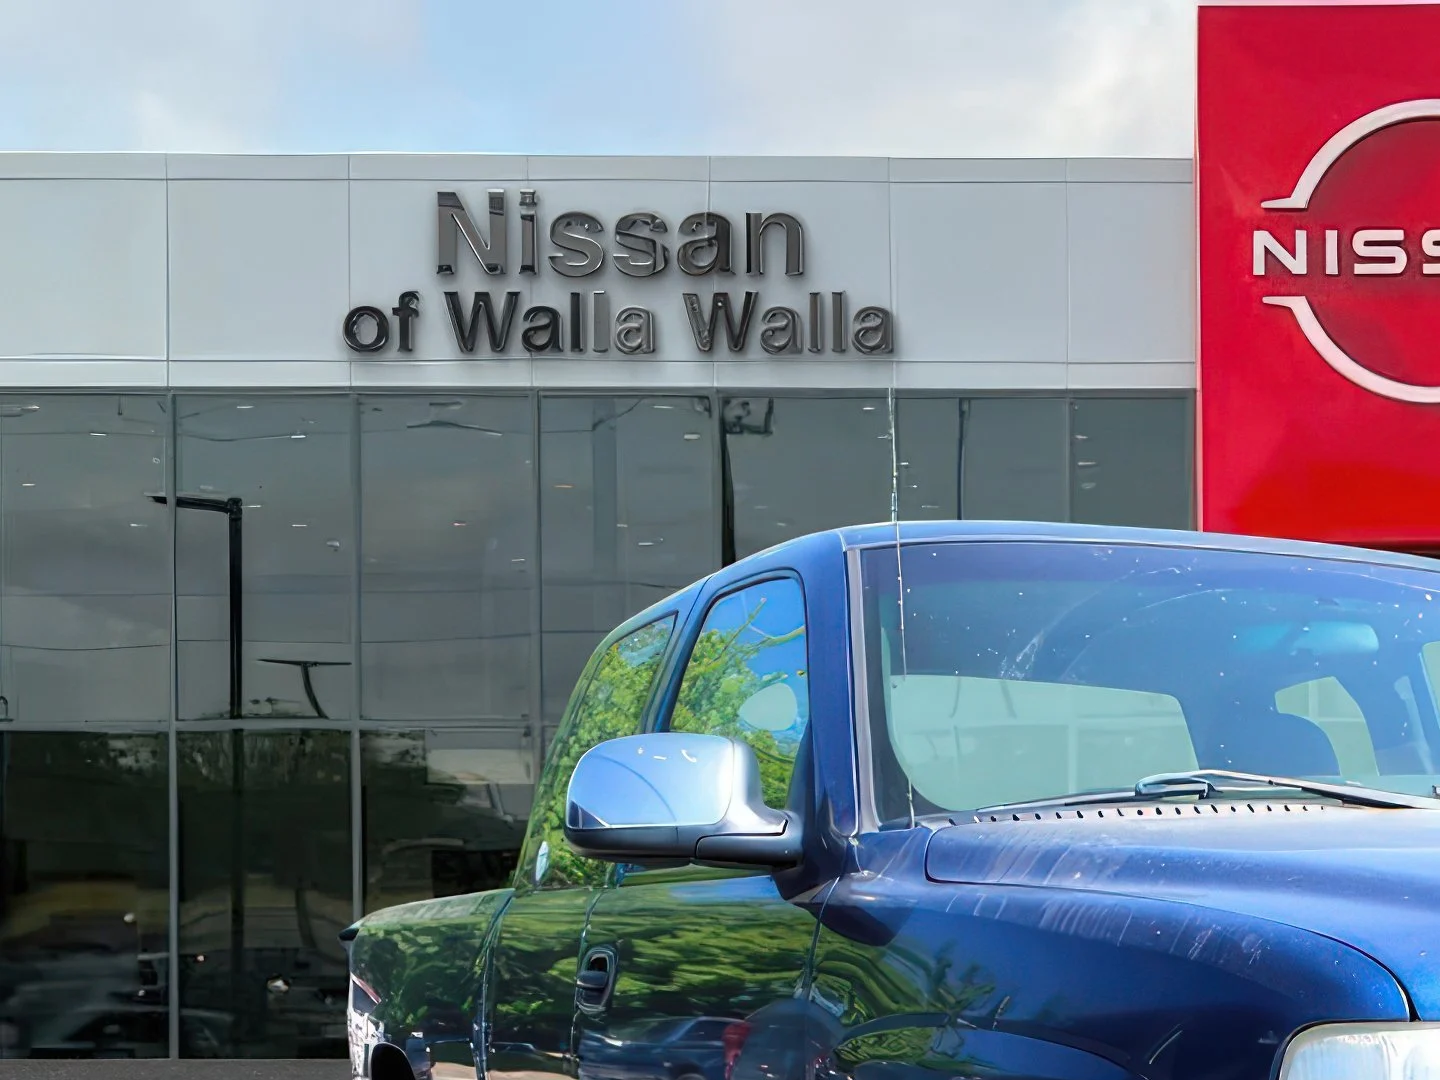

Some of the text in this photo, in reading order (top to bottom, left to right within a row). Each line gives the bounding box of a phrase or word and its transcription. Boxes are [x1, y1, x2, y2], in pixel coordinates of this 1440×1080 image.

[435, 188, 806, 279] Nissan
[342, 290, 893, 354] of Walla Walla
